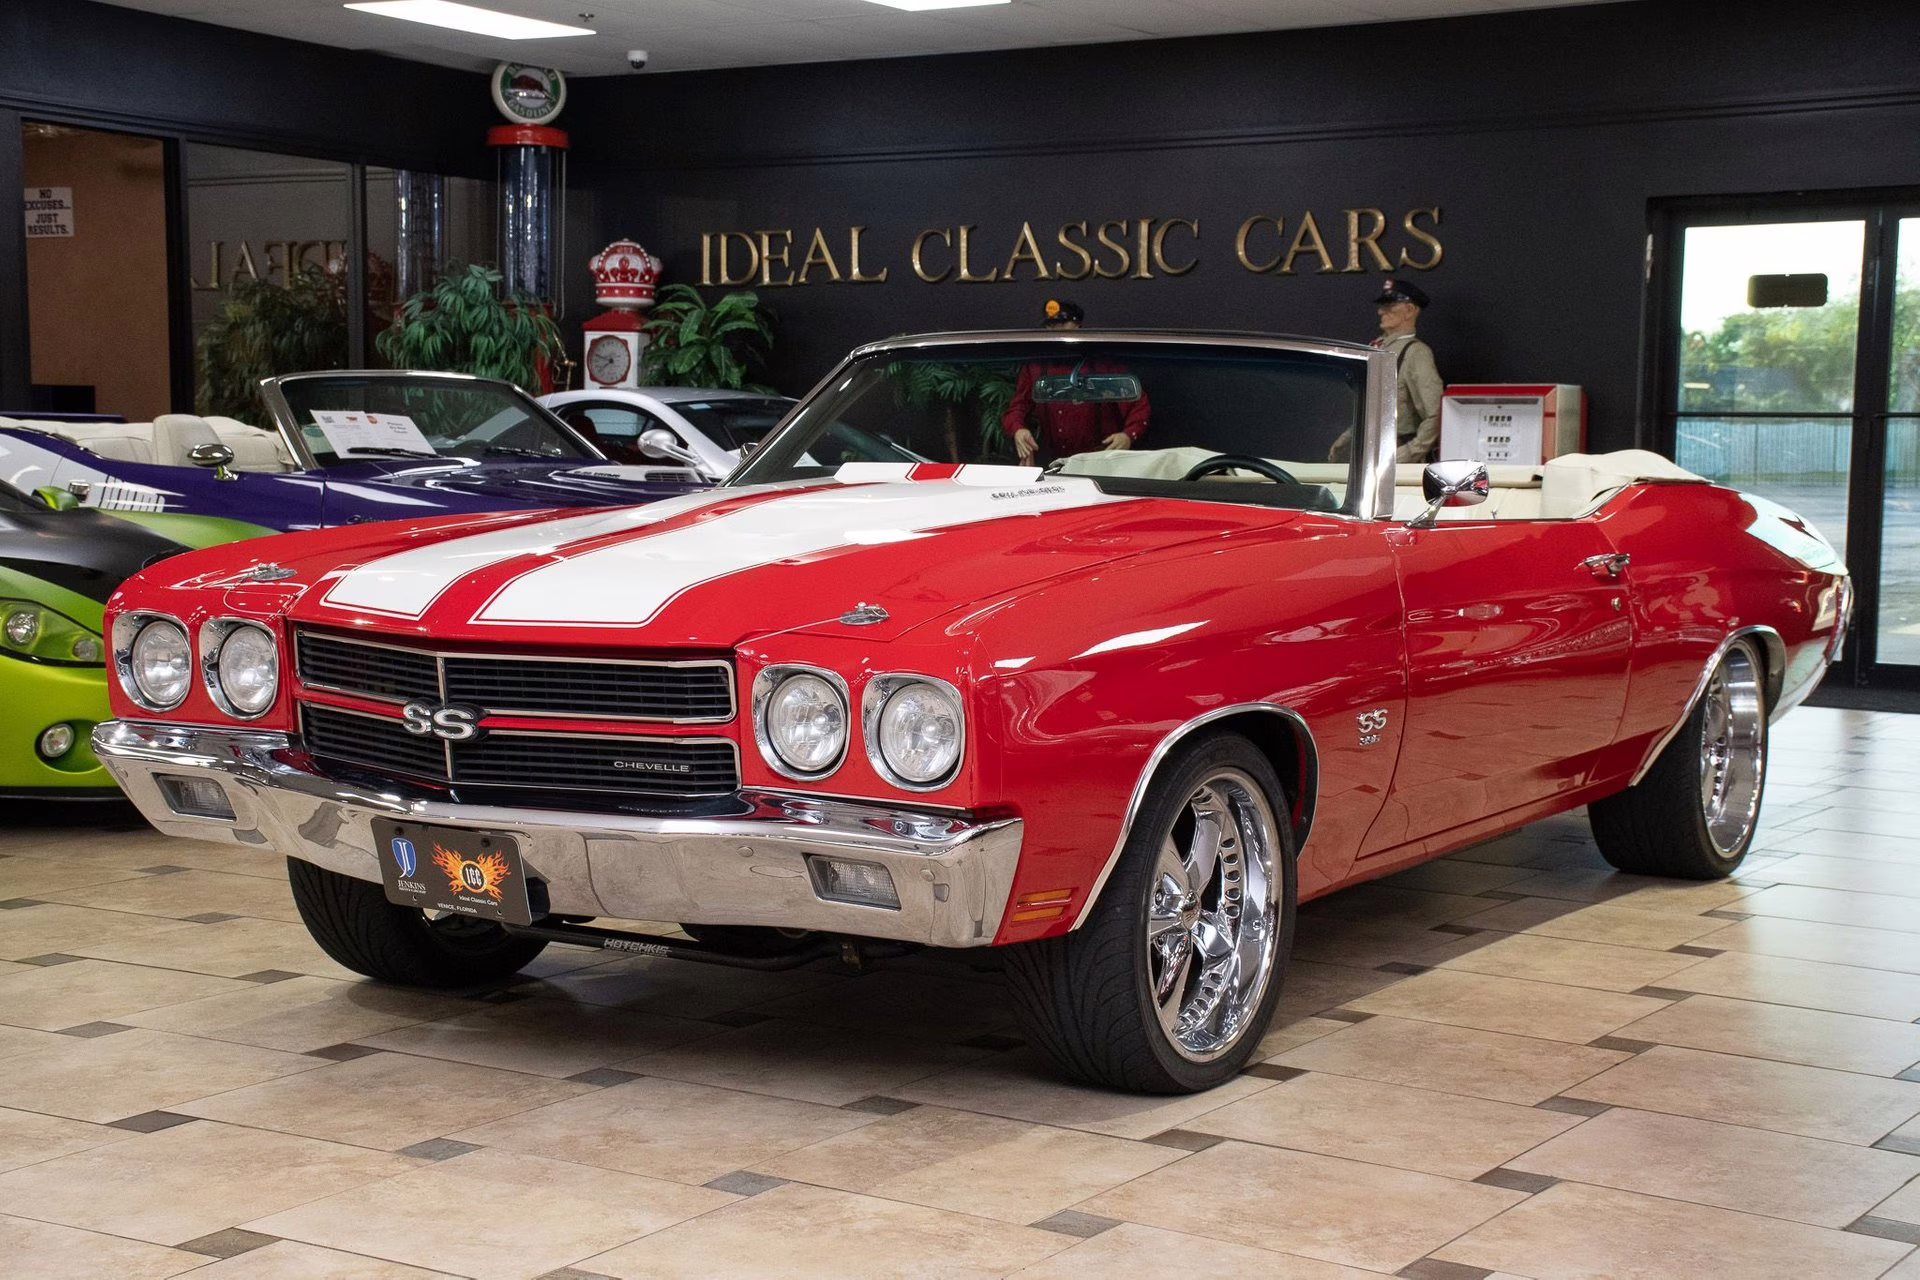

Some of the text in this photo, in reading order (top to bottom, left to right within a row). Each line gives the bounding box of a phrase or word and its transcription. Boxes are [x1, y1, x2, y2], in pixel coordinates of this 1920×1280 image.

[39, 189, 52, 199] NO
[36, 213, 58, 224] JUST
[27, 224, 70, 235] RESULTS.
[698, 207, 1443, 287] IDEAL CLASSIC CARS
[402, 703, 476, 740] SS
[1356, 709, 1389, 733] SS
[614, 761, 690, 773] CHEVELLE
[397, 879, 426, 891] JENKINS
[456, 905, 478, 914] FLORIDA
[604, 938, 673, 955] HOTCHKIS
